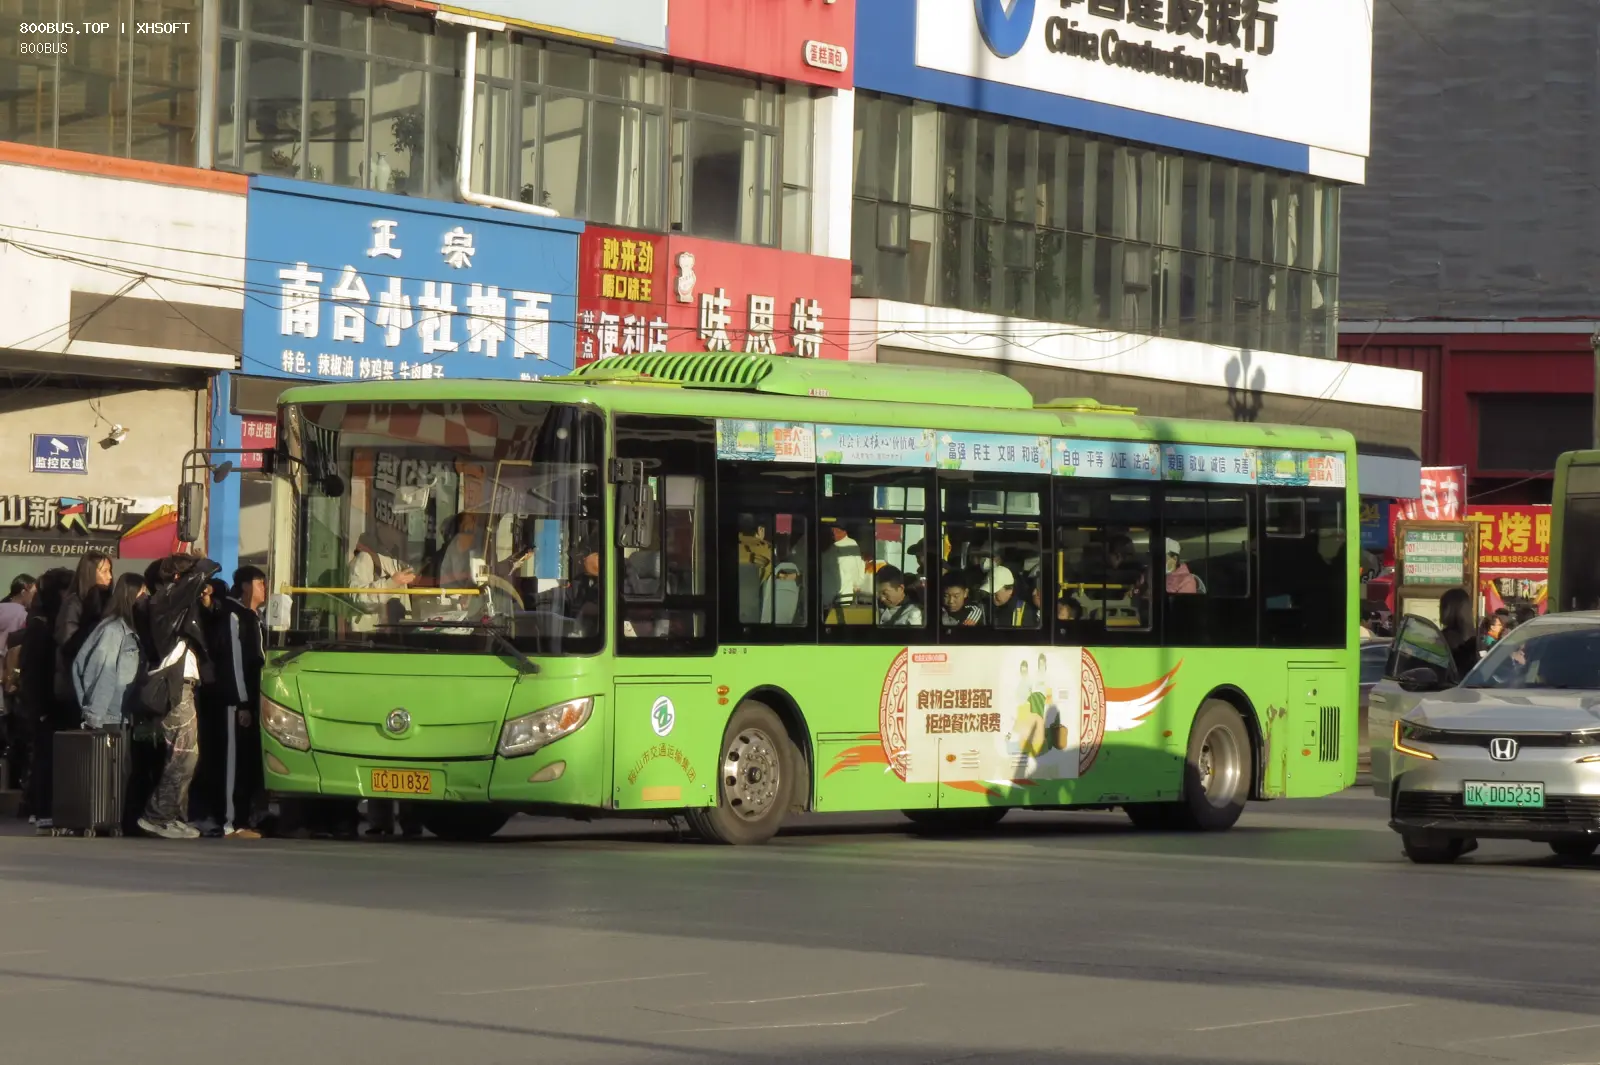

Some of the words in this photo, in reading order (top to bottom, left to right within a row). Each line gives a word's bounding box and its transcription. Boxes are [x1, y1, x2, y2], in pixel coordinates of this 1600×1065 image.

[810, 44, 842, 67] 蛋糕面包
[1045, 15, 1099, 62] China
[1101, 28, 1203, 83] Construction
[1205, 51, 1249, 93] Bank
[366, 219, 476, 269] 正宗
[602, 238, 653, 273] 秒来劲
[698, 287, 824, 359] 味思特
[597, 311, 669, 361] 便利店
[35, 456, 85, 470] 监控区域
[948, 442, 967, 461] 富强
[973, 443, 991, 462] 民主
[997, 445, 1016, 462] 文明
[1022, 445, 1040, 464] 和谐
[1063, 449, 1080, 466] 自由
[1086, 450, 1104, 468] 平等
[1110, 452, 1127, 469] 公正
[1133, 453, 1150, 470] 法治
[1167, 453, 1184, 471] 爱国
[1189, 455, 1205, 472] 敬业
[1210, 456, 1226, 473] 诚信
[1233, 457, 1249, 475] 友善
[917, 688, 993, 709] 食物合理搭配
[925, 712, 1001, 734] 拒绝餐饮浪费
